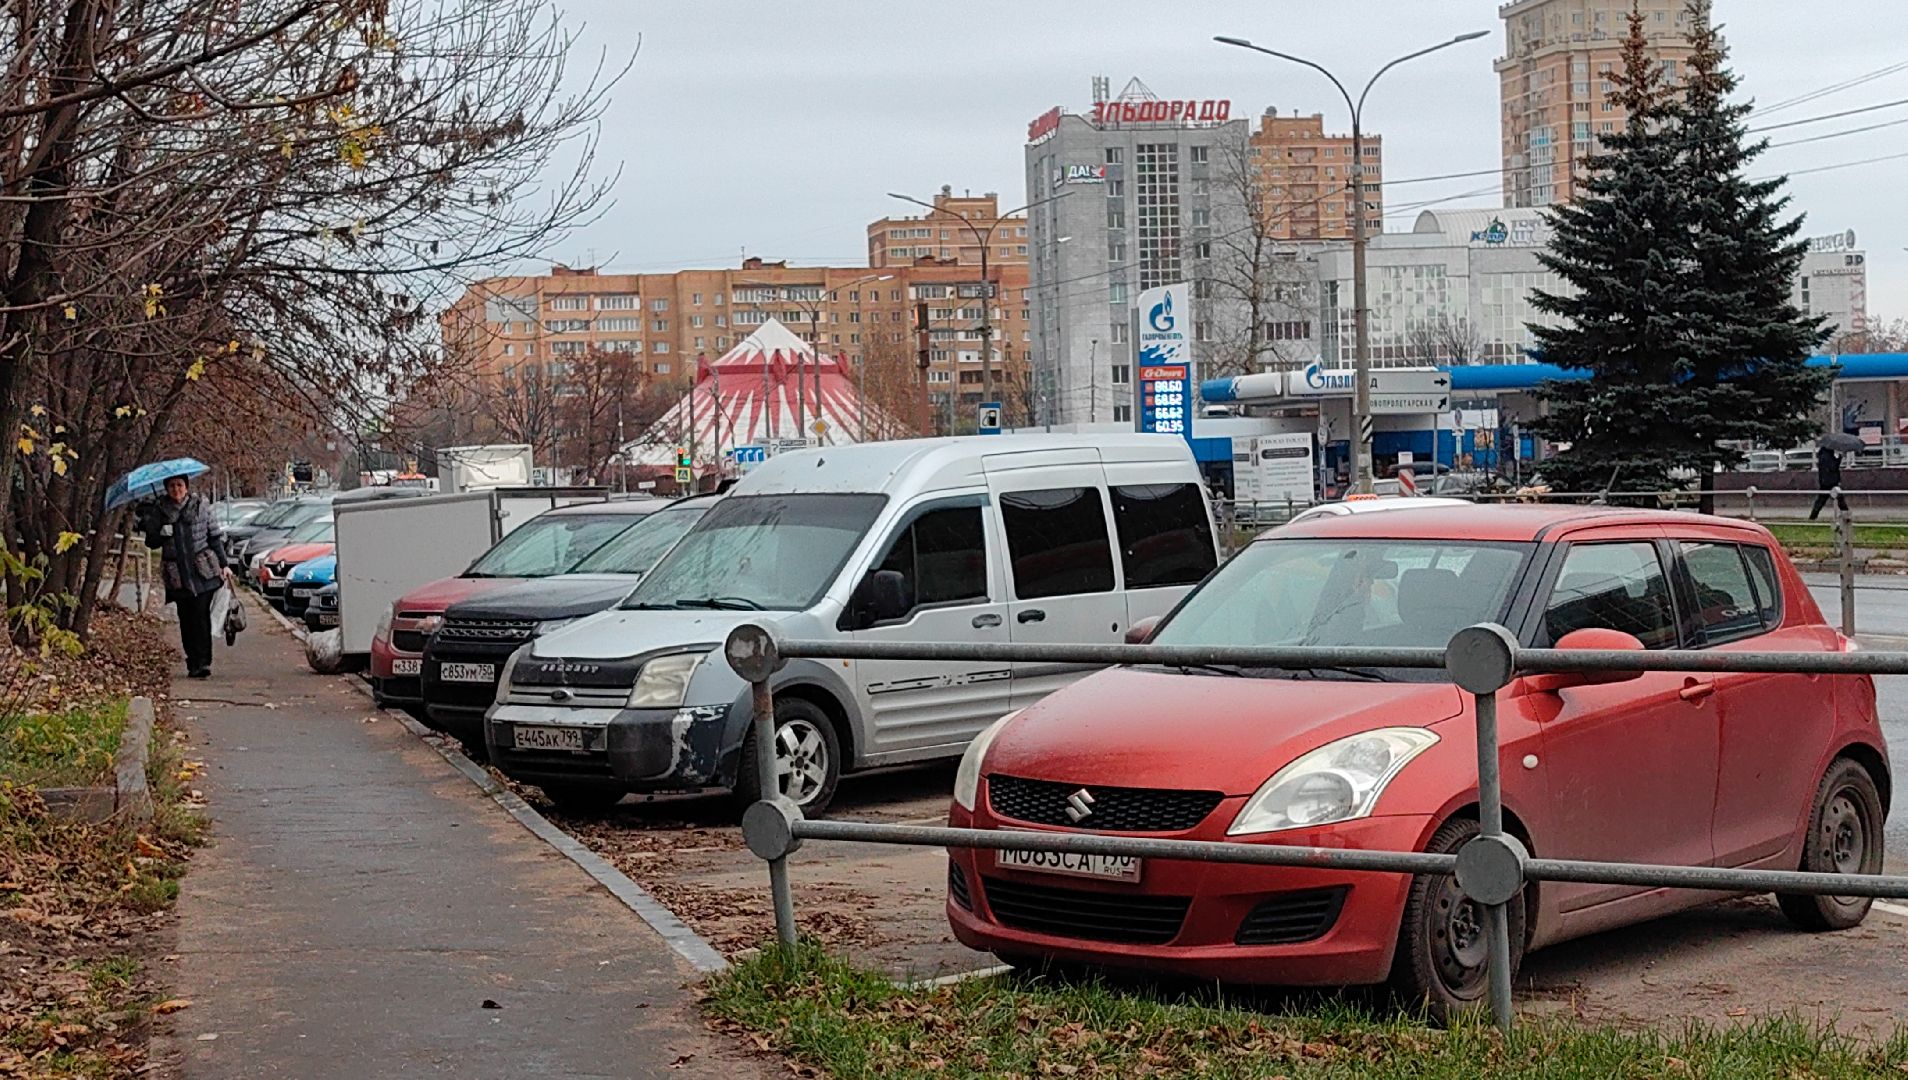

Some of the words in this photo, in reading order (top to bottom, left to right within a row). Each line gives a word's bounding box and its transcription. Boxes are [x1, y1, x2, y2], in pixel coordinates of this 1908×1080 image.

[1089, 100, 1231, 123] ЭЛЬДОРАДО
[1369, 399, 1434, 408] ОВОПРОЛЕТАРСКАЯ
[1104, 866, 1121, 876] RUS
